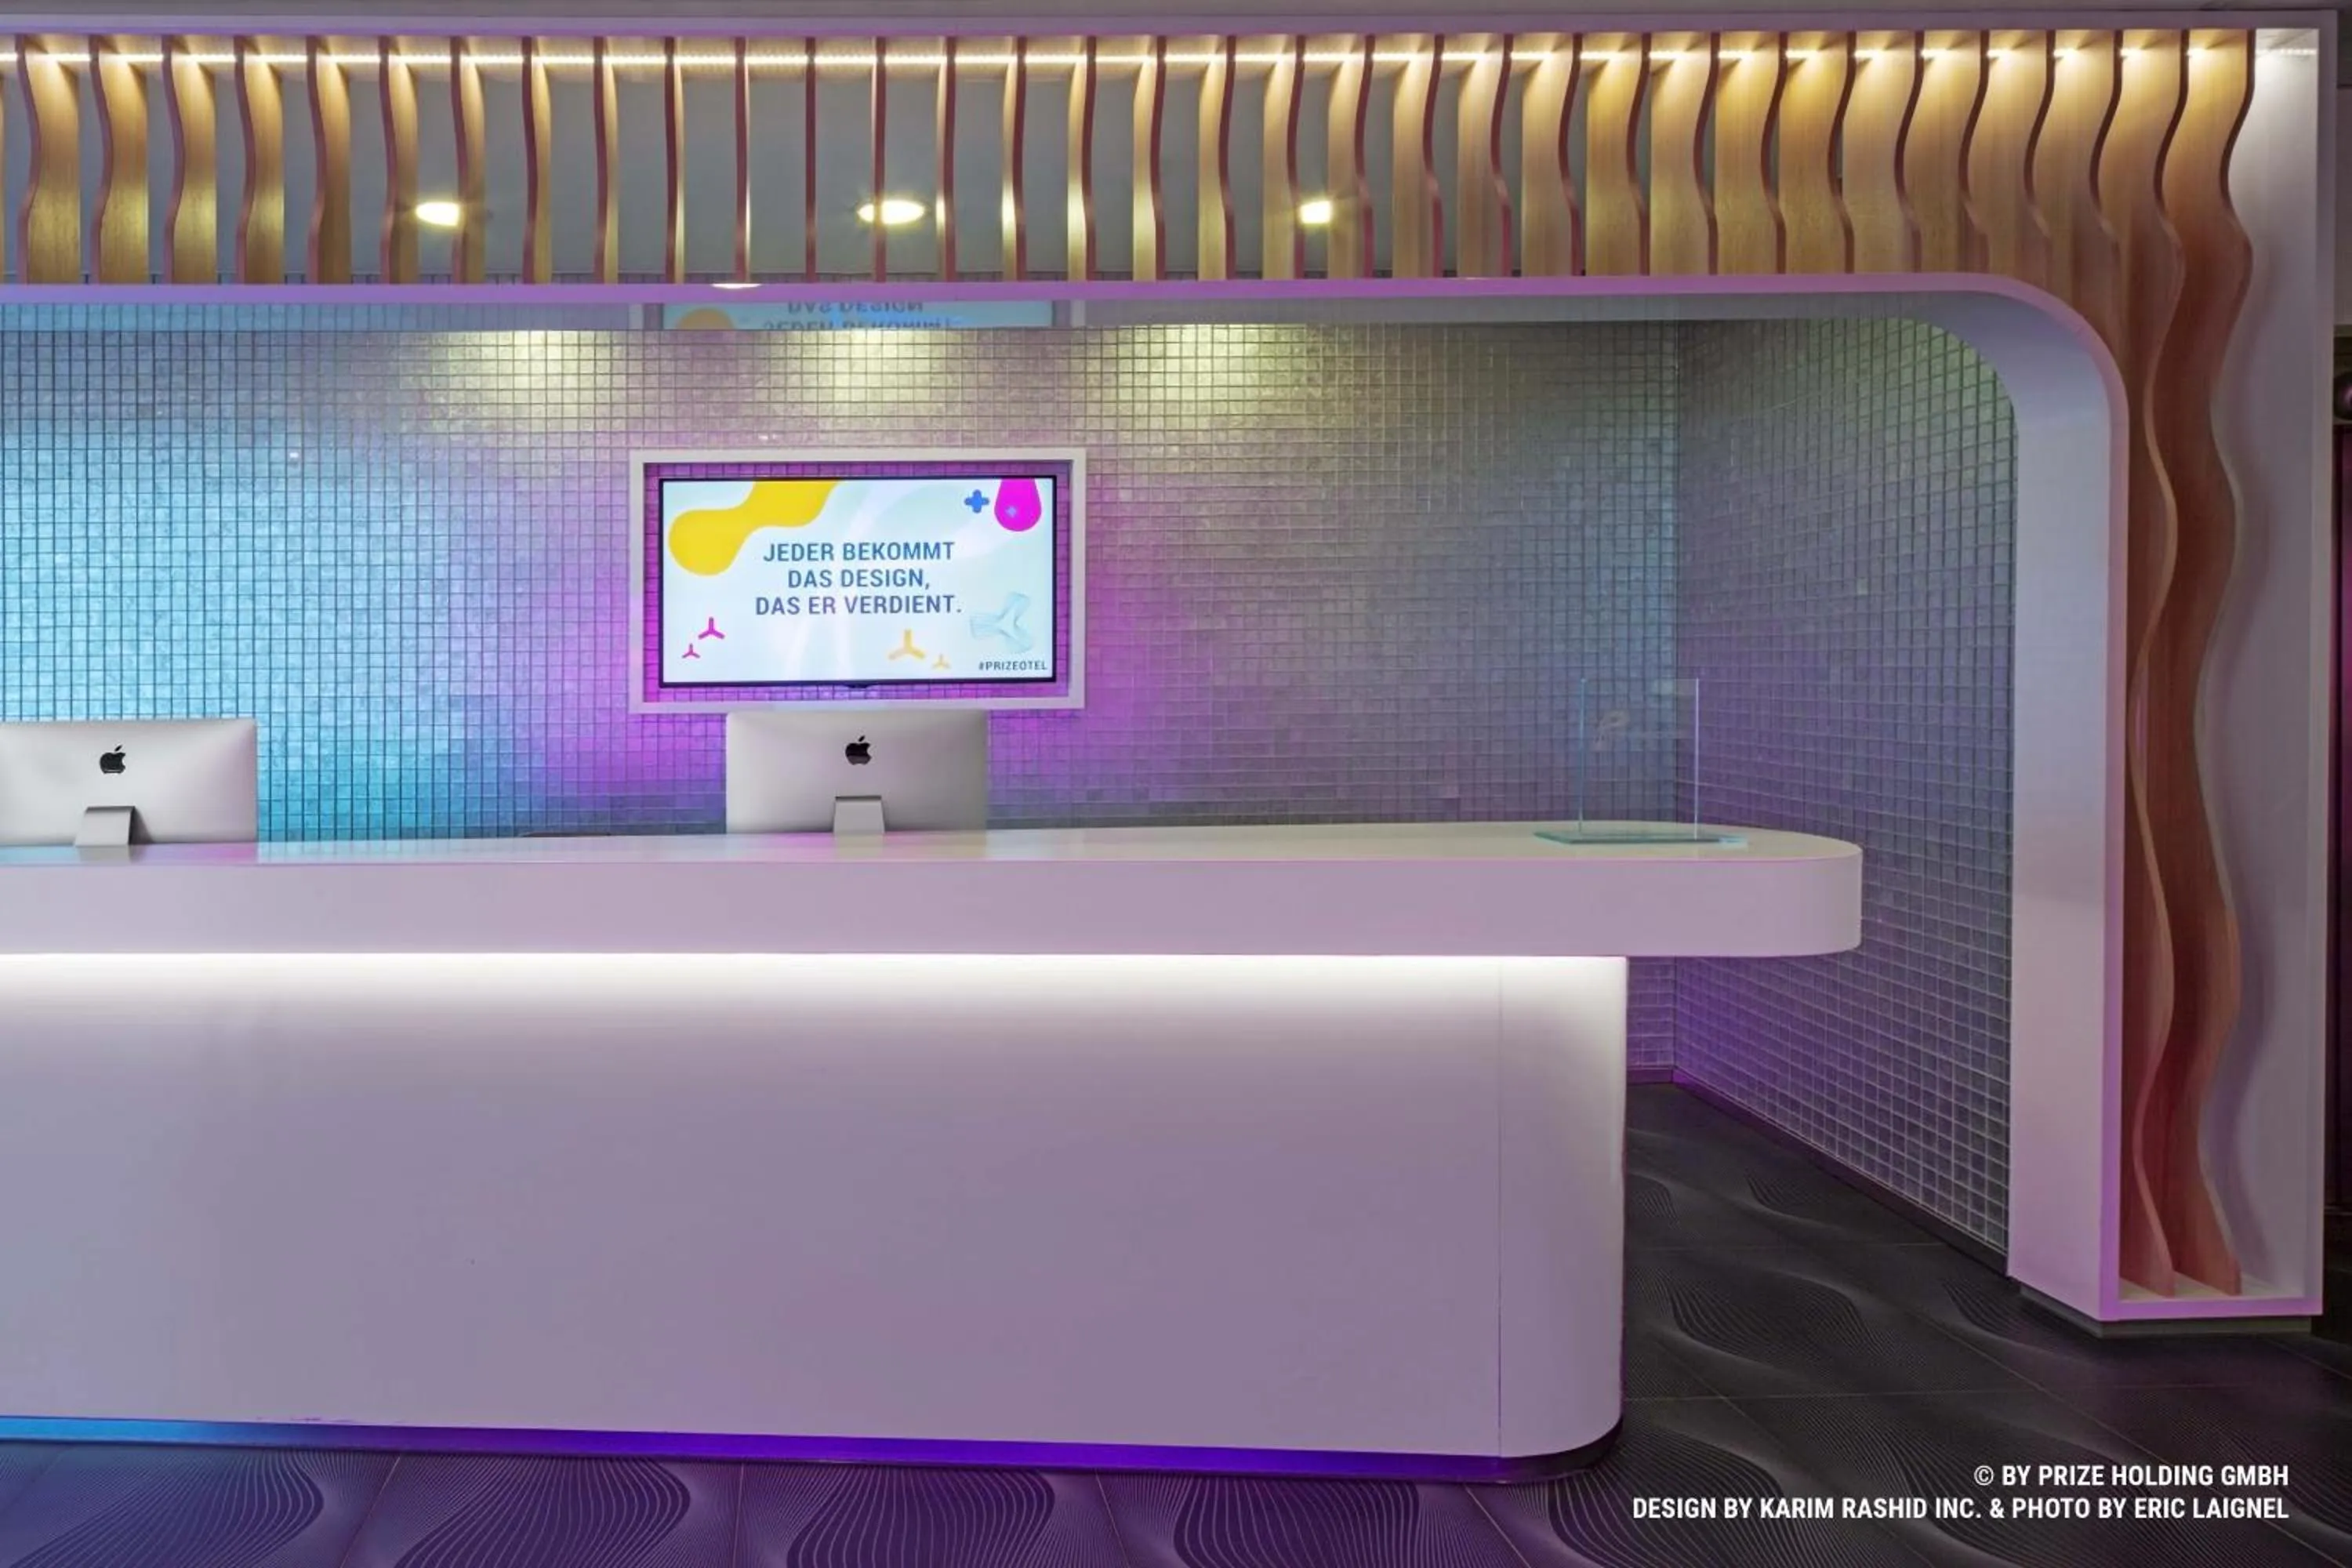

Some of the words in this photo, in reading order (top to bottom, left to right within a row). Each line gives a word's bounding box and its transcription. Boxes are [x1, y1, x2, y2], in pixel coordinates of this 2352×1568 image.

[764, 543, 834, 562] JEDER
[843, 542, 955, 561] BEKOMMT
[788, 569, 832, 588] DAS
[841, 568, 930, 590] DESIGN,
[756, 597, 800, 615] DAS
[808, 597, 836, 615] ER
[844, 595, 961, 614] VERDIENT.
